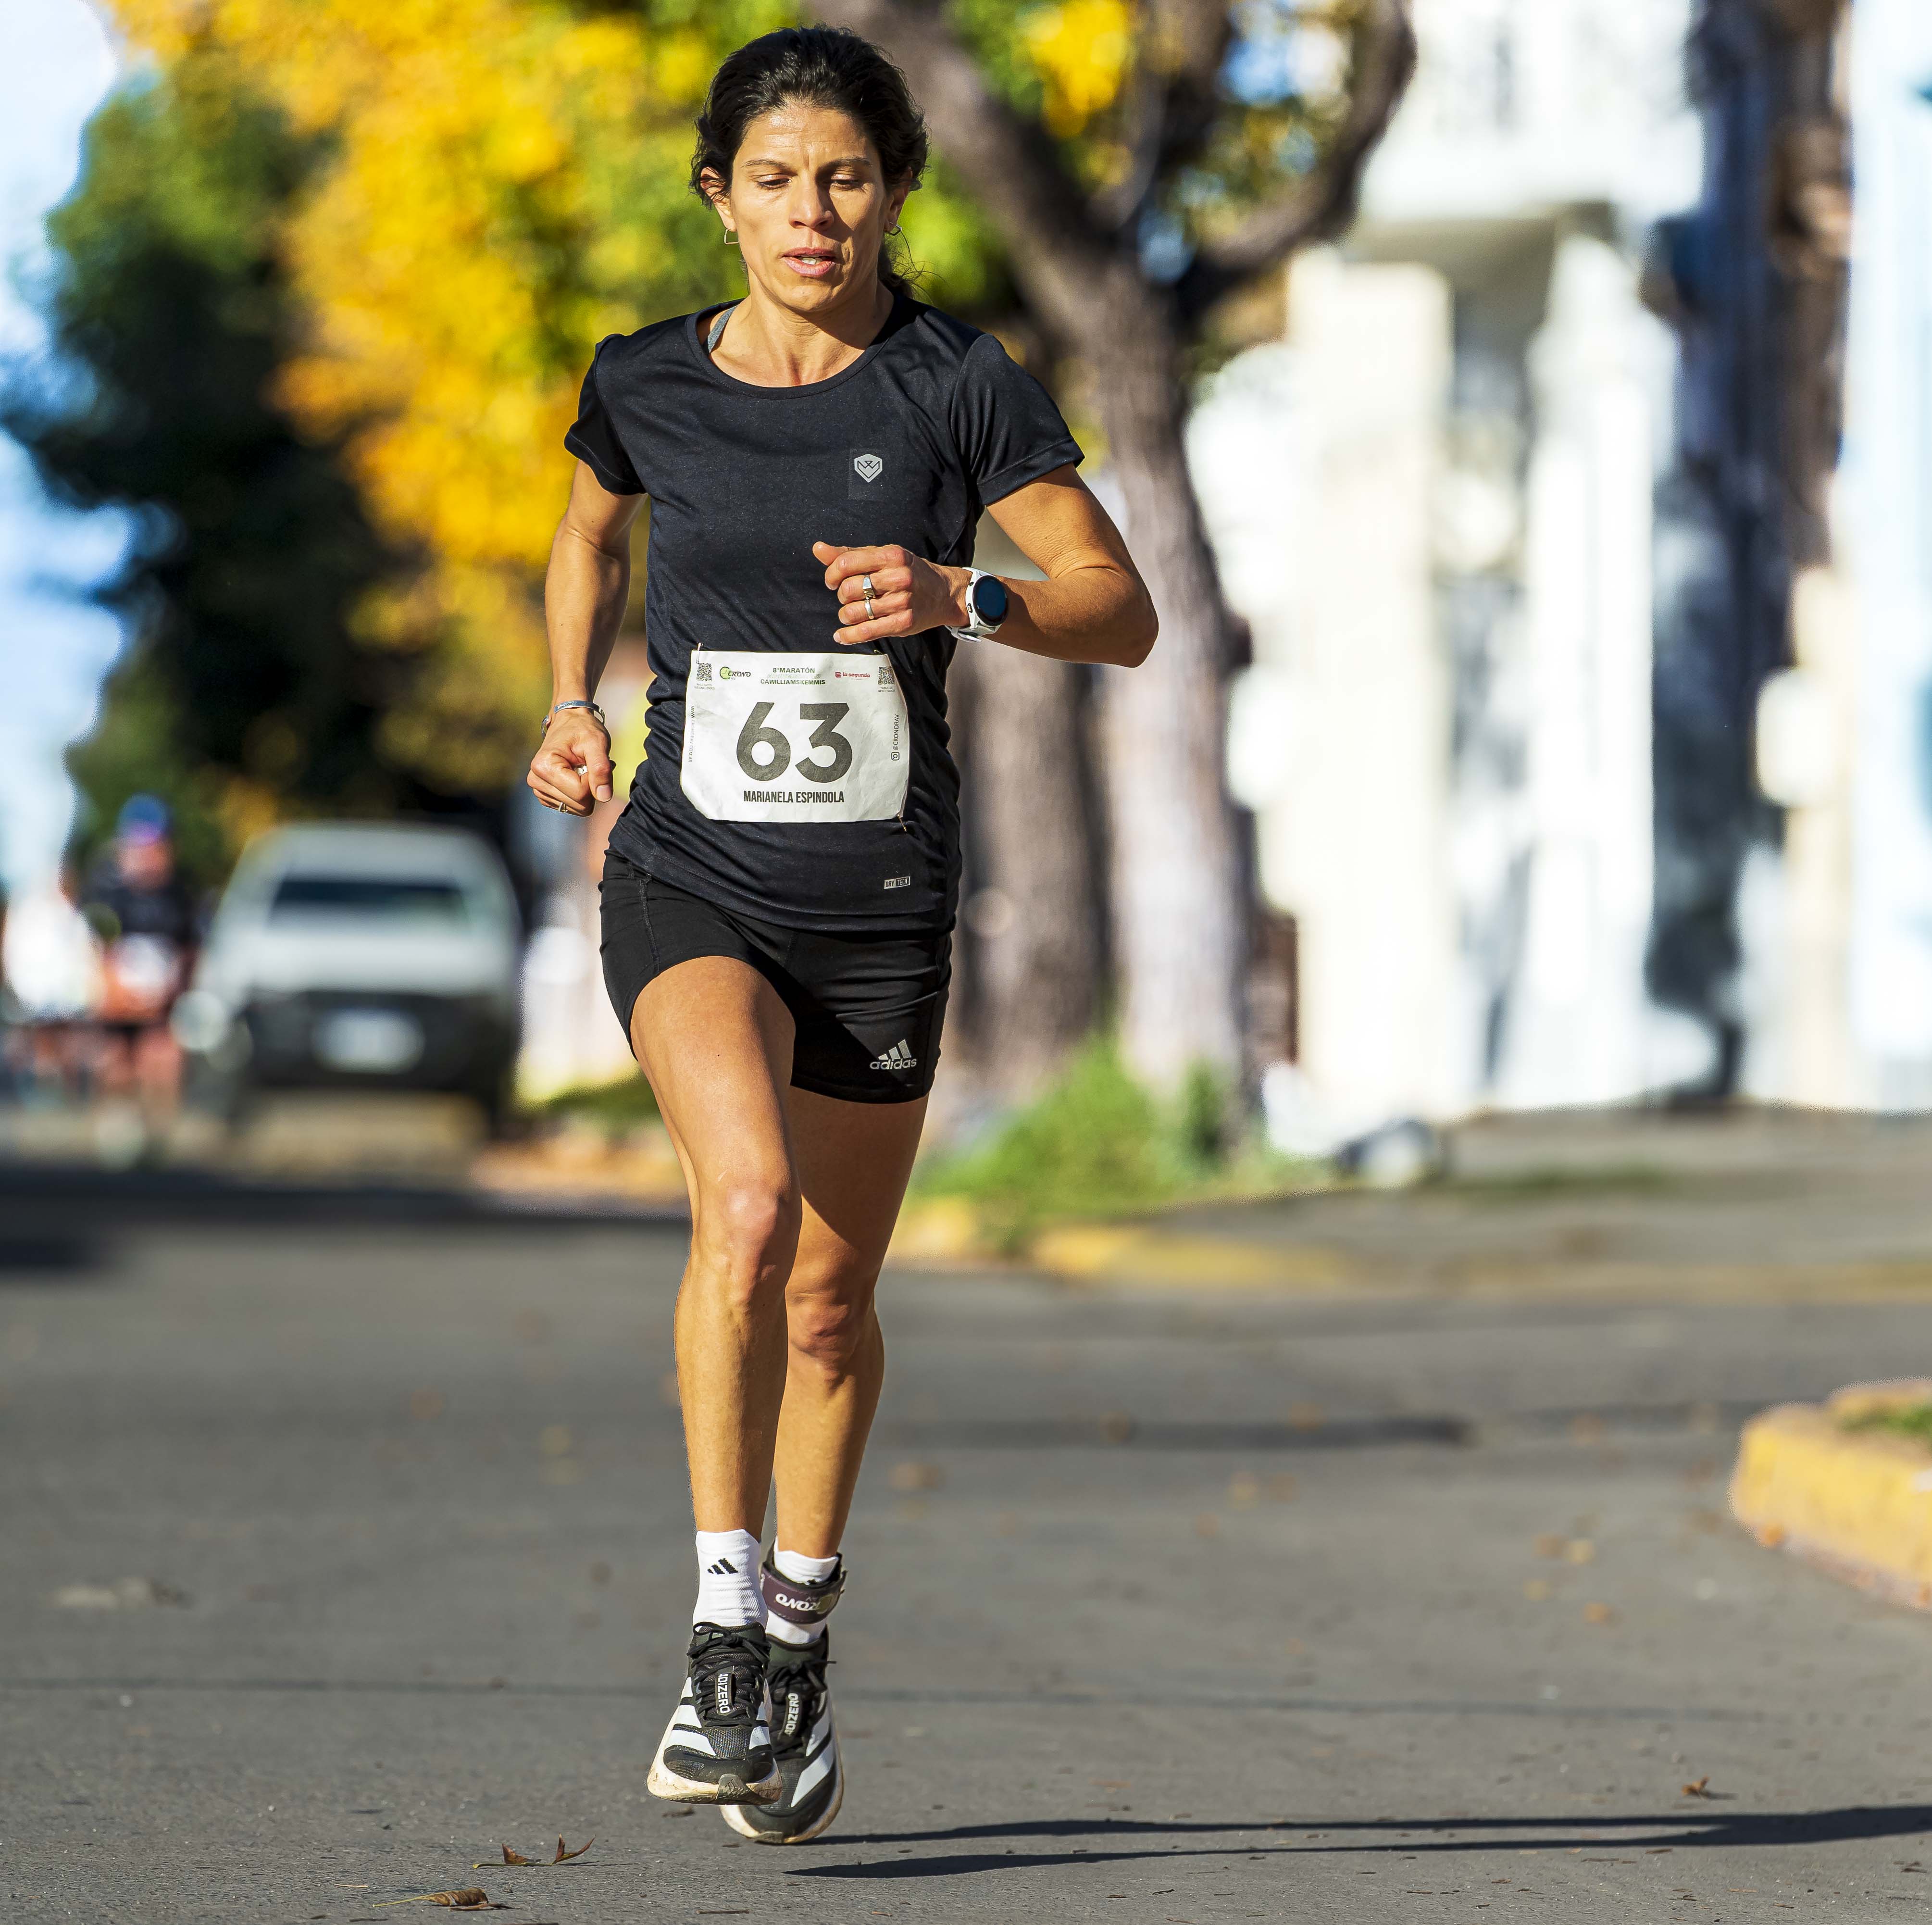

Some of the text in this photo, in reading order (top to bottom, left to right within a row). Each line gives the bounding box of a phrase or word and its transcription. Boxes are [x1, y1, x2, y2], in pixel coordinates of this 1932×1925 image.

[736, 702, 853, 783] 63
[744, 791, 845, 803] MARIANELA ESPINDOLA
[870, 1058, 917, 1070] adidas
[717, 1673, 731, 1714] ADIZERO
[784, 1693, 799, 1737] ADIZERO
